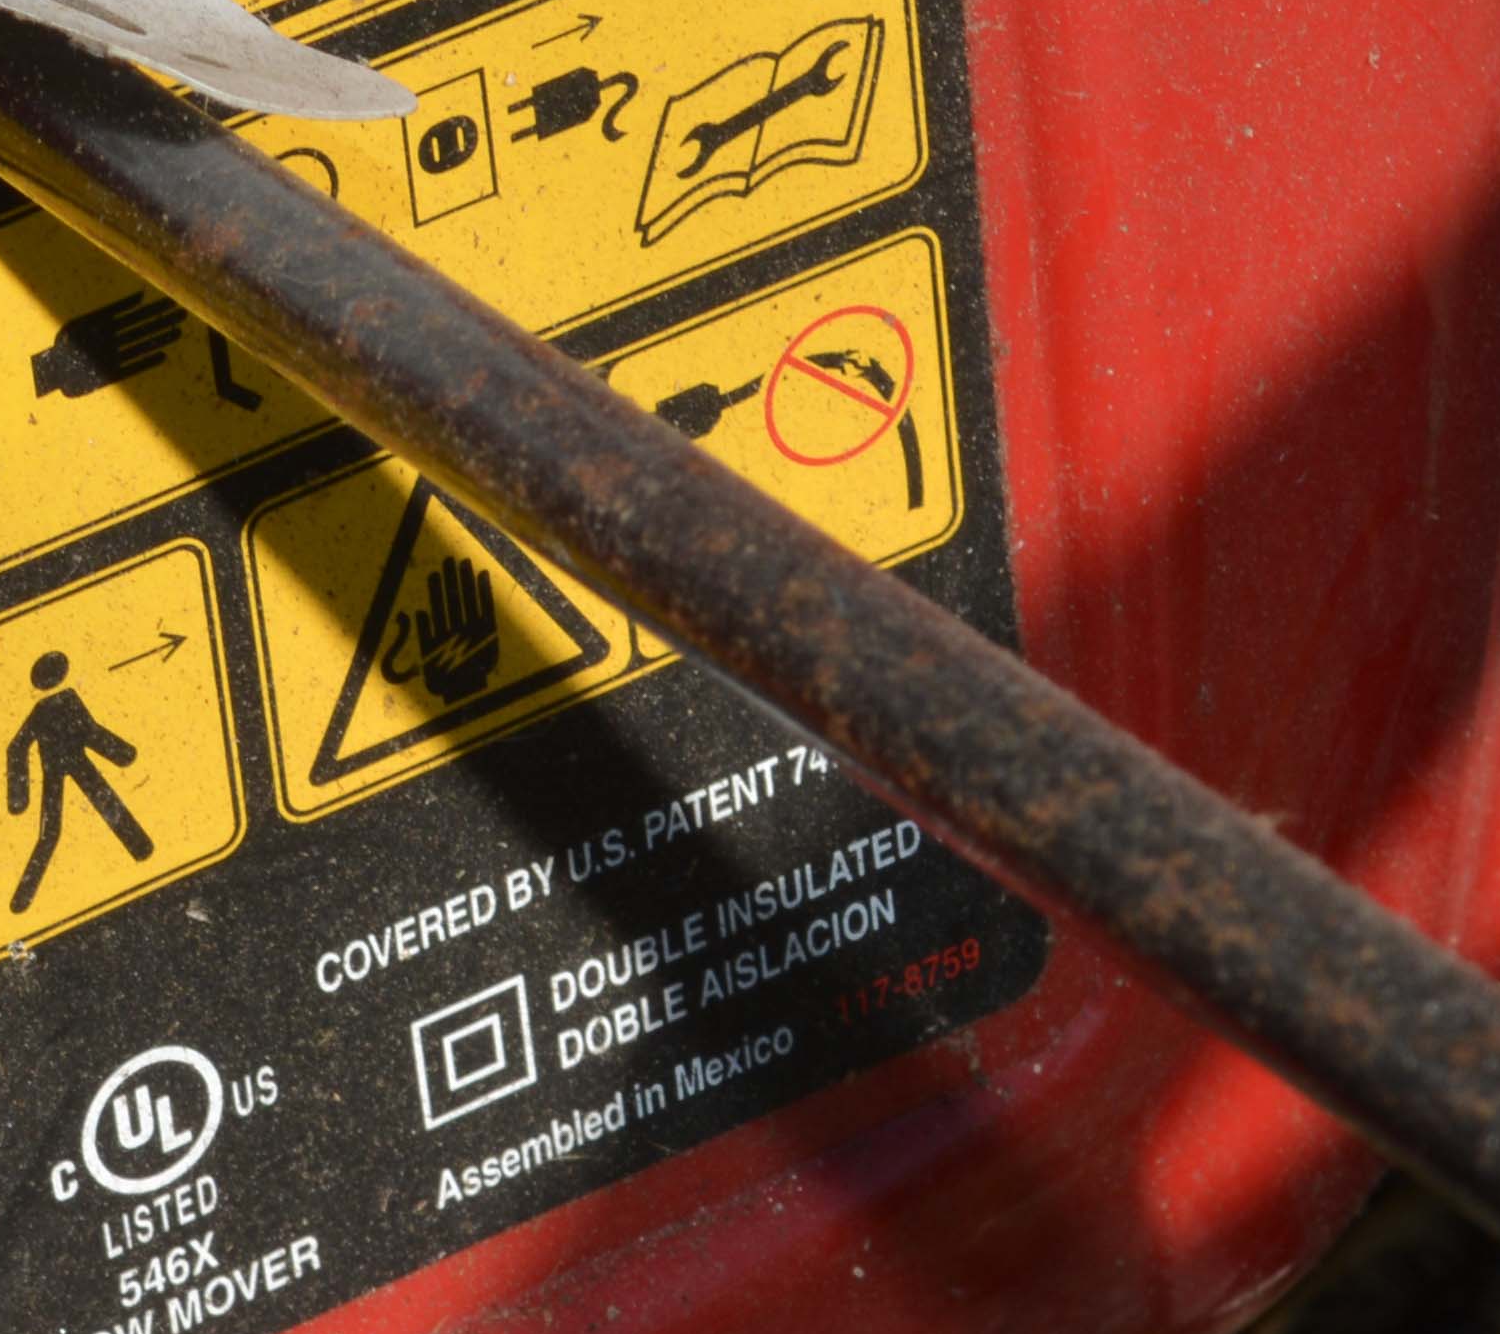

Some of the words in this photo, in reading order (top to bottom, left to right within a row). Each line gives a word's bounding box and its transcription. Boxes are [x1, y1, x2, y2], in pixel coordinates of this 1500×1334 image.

[316, 885, 497, 993] COVERED
[506, 856, 554, 911] BY
[567, 828, 636, 883] U.S.
[643, 756, 779, 850] PATENT
[550, 912, 707, 1013] DOUBLE
[717, 819, 921, 938] INSULATED
[557, 983, 686, 1070] DOBLE
[700, 888, 895, 1008] AISLACION
[111, 1085, 194, 1154] UL
[231, 1065, 278, 1117] US
[437, 1092, 625, 1210] Assembled
[633, 1083, 666, 1119] in
[674, 1026, 794, 1101] Mexico
[103, 1175, 218, 1259] LISTED
[119, 1231, 219, 1308] 546X
[166, 1235, 322, 1334] MOVER
